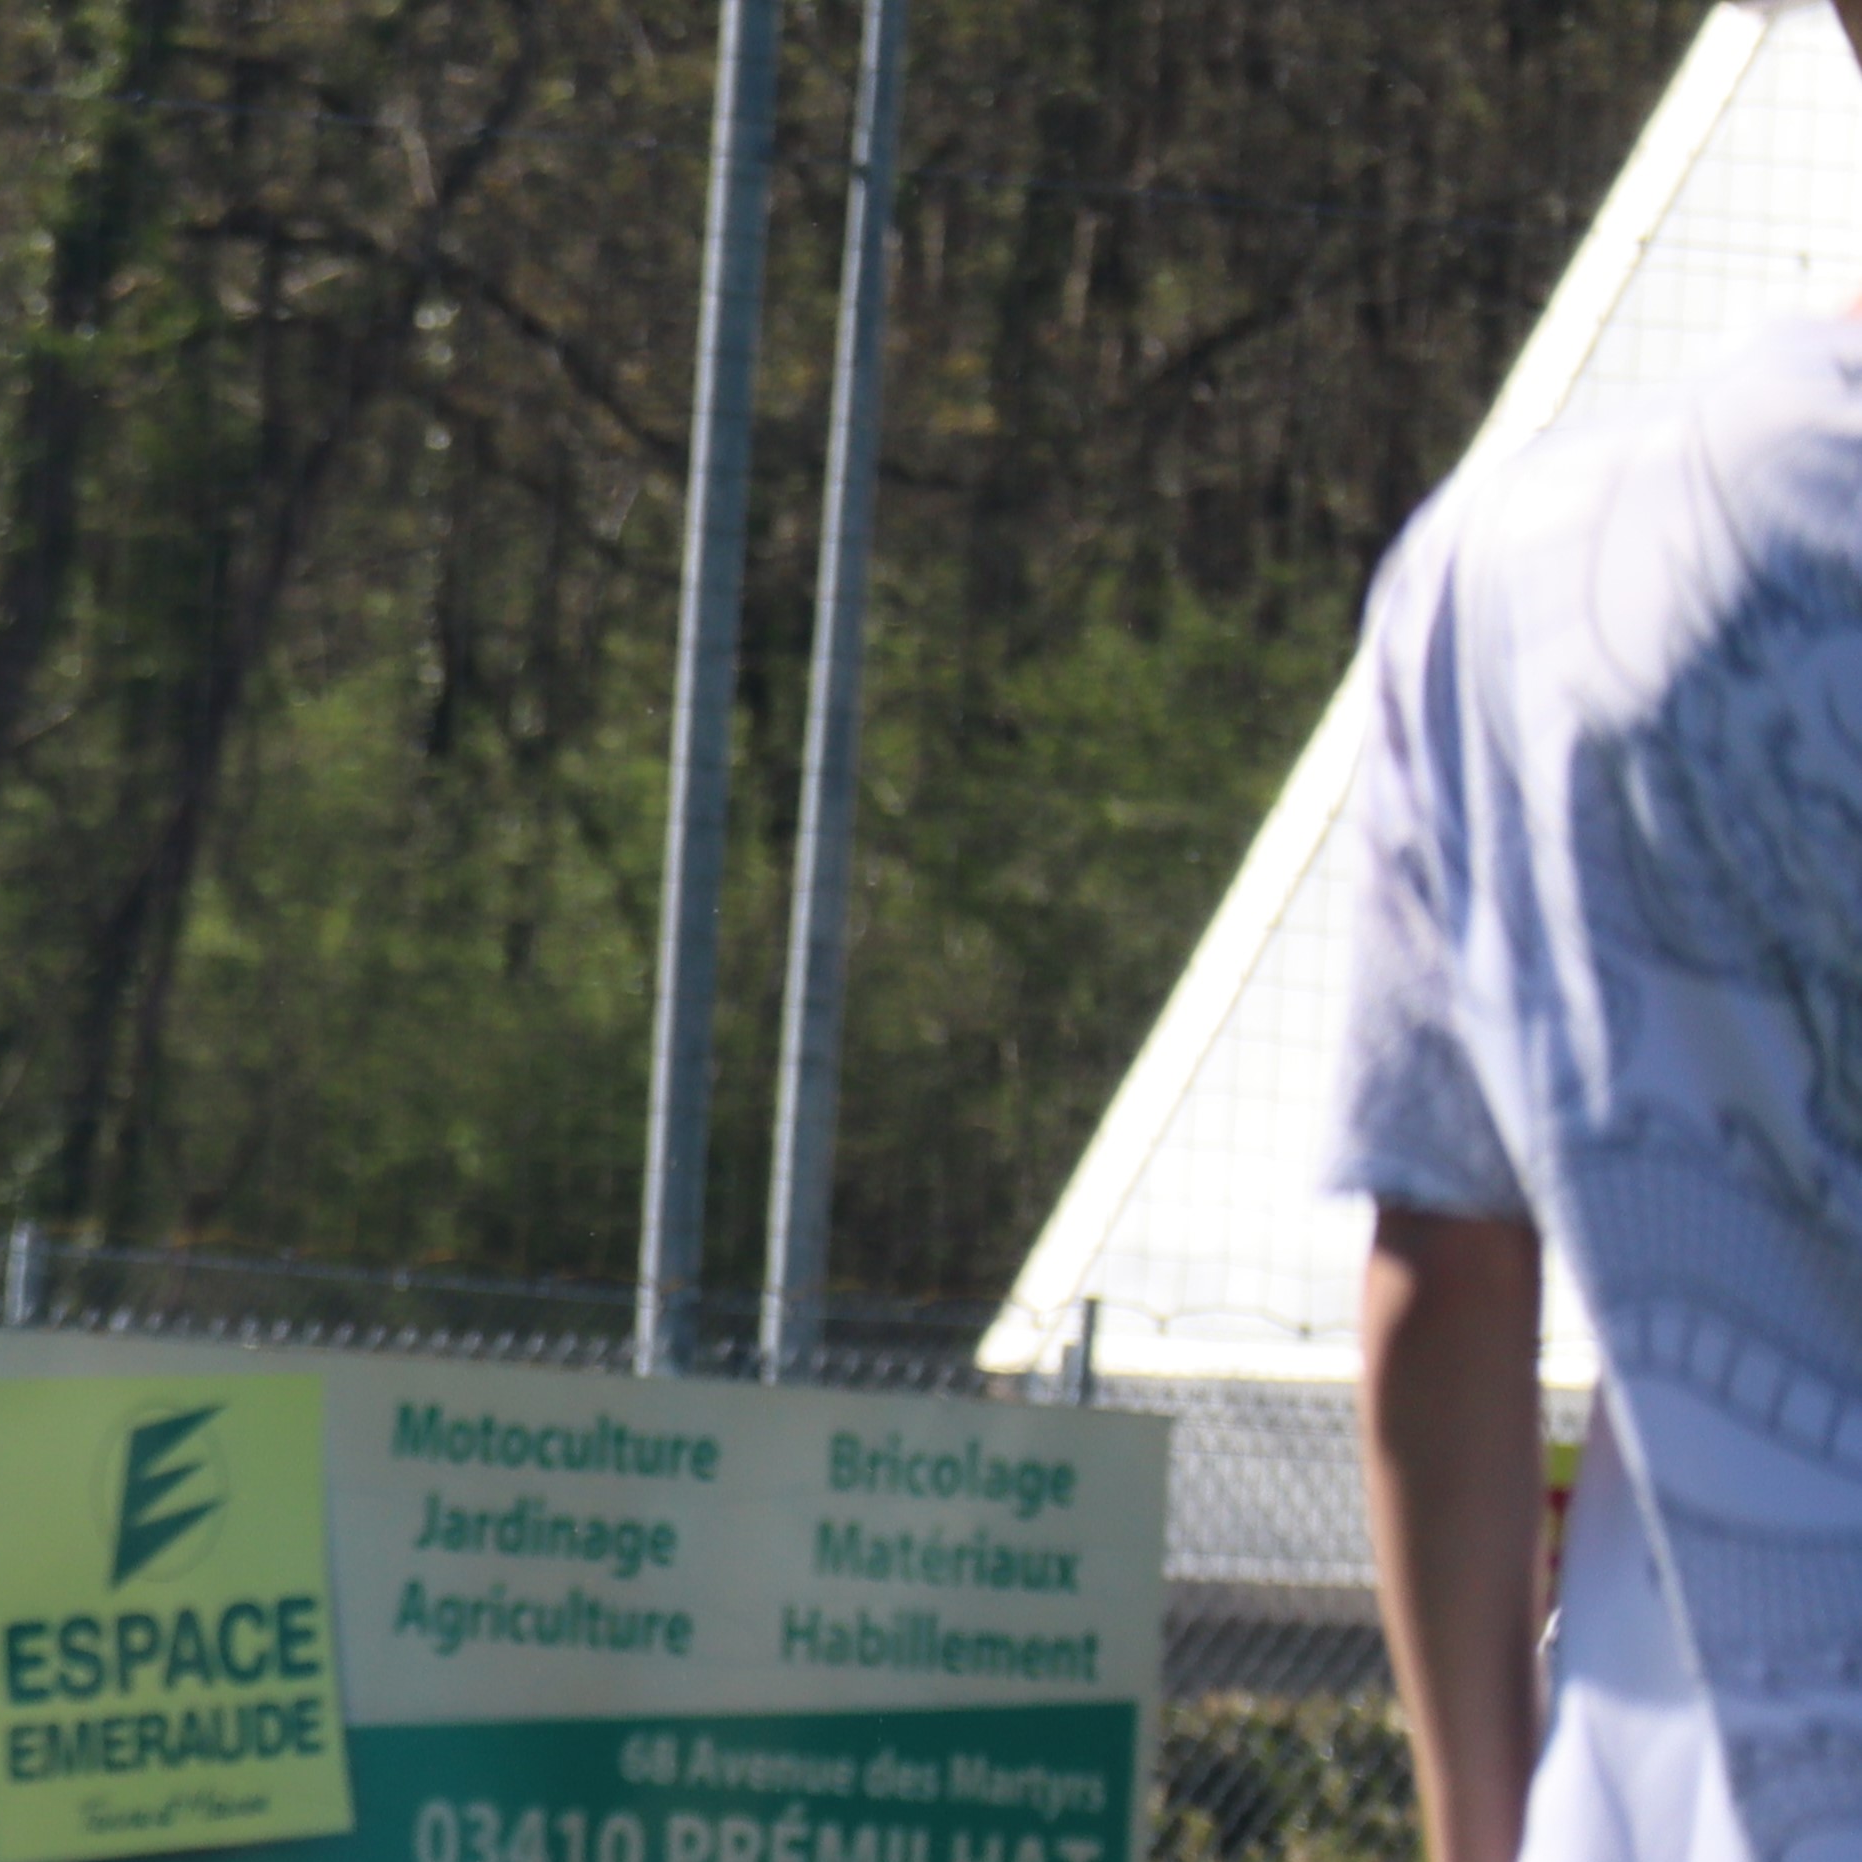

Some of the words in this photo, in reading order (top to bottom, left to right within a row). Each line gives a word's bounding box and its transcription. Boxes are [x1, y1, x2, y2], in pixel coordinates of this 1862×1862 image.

[390, 1402, 721, 1481] Motoculture
[828, 1432, 1077, 1518] Bricolage
[413, 1491, 679, 1579] Jardinage
[812, 1519, 1081, 1595] Matériaux
[4, 1595, 322, 1704] ESPACE
[392, 1578, 695, 1658] Agriculture
[780, 1604, 1102, 1684] Habillement
[7, 1697, 325, 1783] EMERAUDE
[685, 1736, 855, 1798] Avenue
[862, 1746, 940, 1802] des
